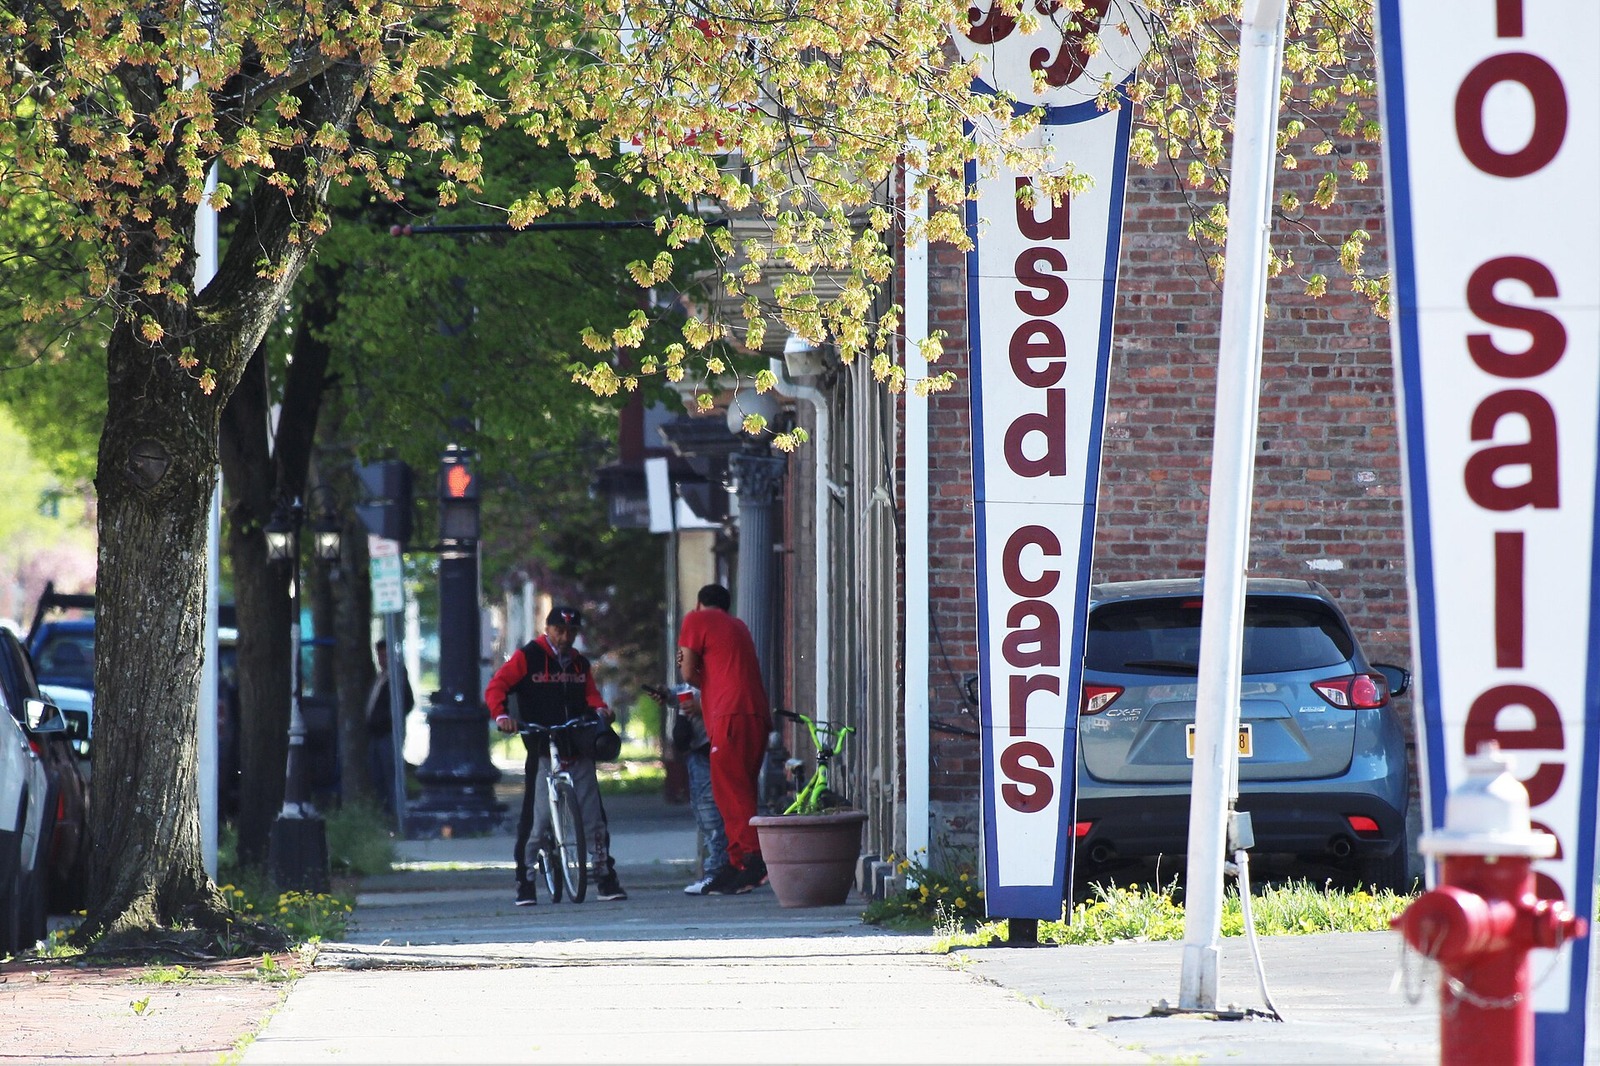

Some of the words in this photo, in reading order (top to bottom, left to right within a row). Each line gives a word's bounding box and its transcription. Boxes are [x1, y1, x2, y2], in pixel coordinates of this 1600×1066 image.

[1003, 176, 1071, 477] used
[1000, 524, 1062, 814] cars
[1105, 708, 1142, 718] CX-5
